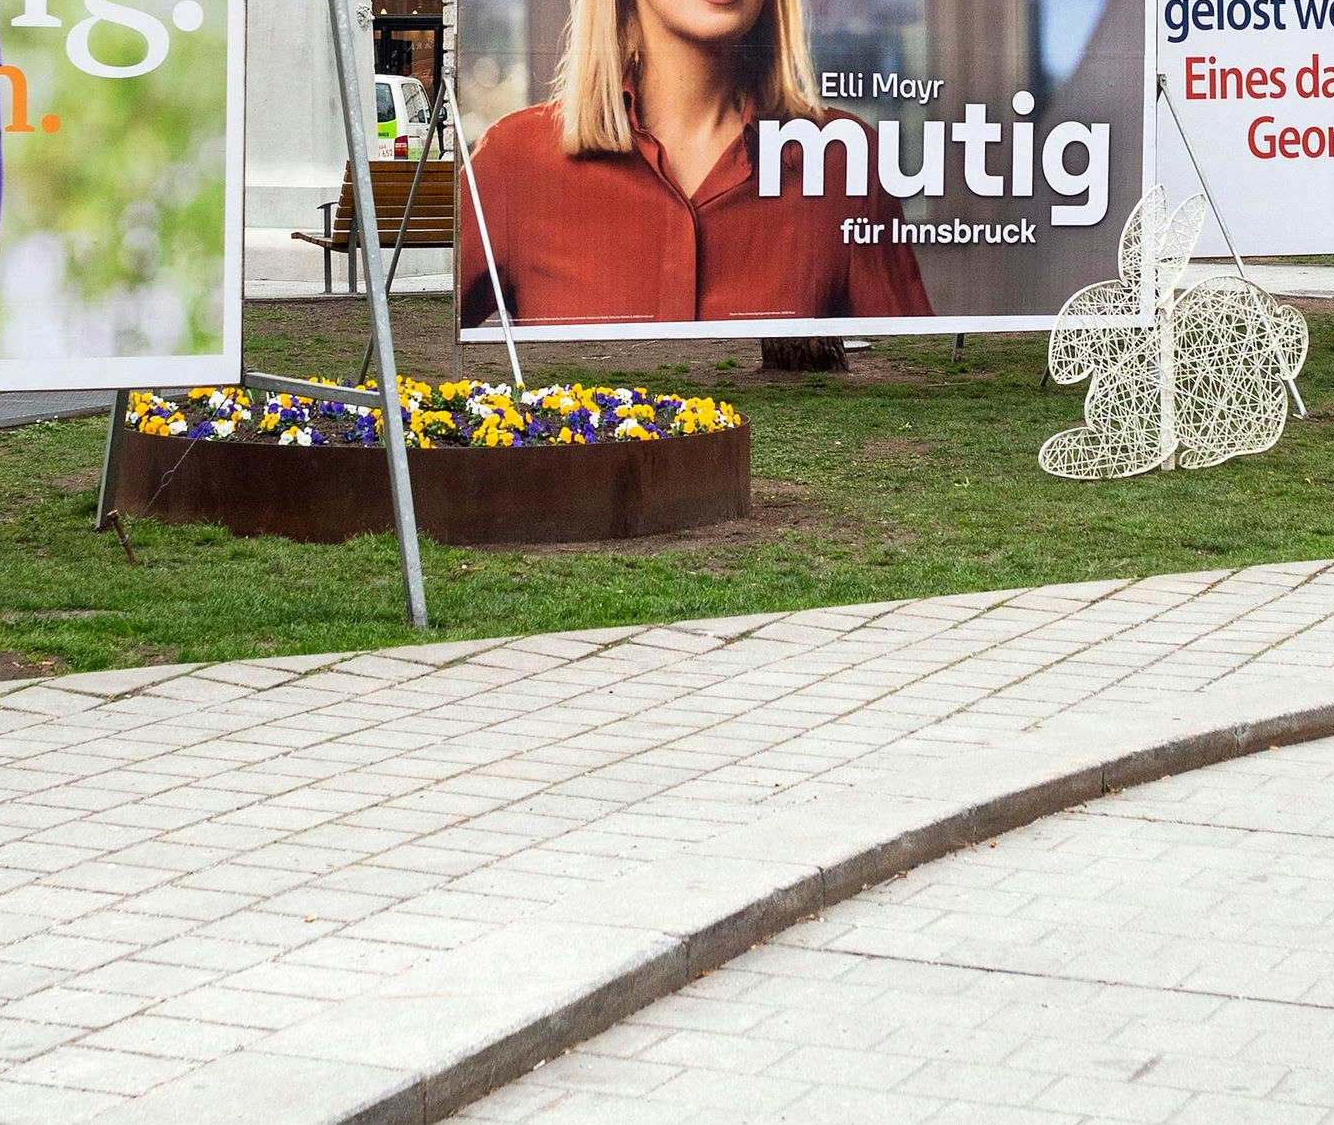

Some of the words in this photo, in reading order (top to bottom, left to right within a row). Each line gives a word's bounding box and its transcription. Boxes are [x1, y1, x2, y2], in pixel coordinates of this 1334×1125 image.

[821, 72, 864, 98] Elli
[873, 73, 944, 104] Mayr
[1185, 56, 1287, 100] Eines
[758, 90, 1110, 227] mutig
[840, 218, 885, 244] für
[892, 219, 1036, 244] Innsbruck
